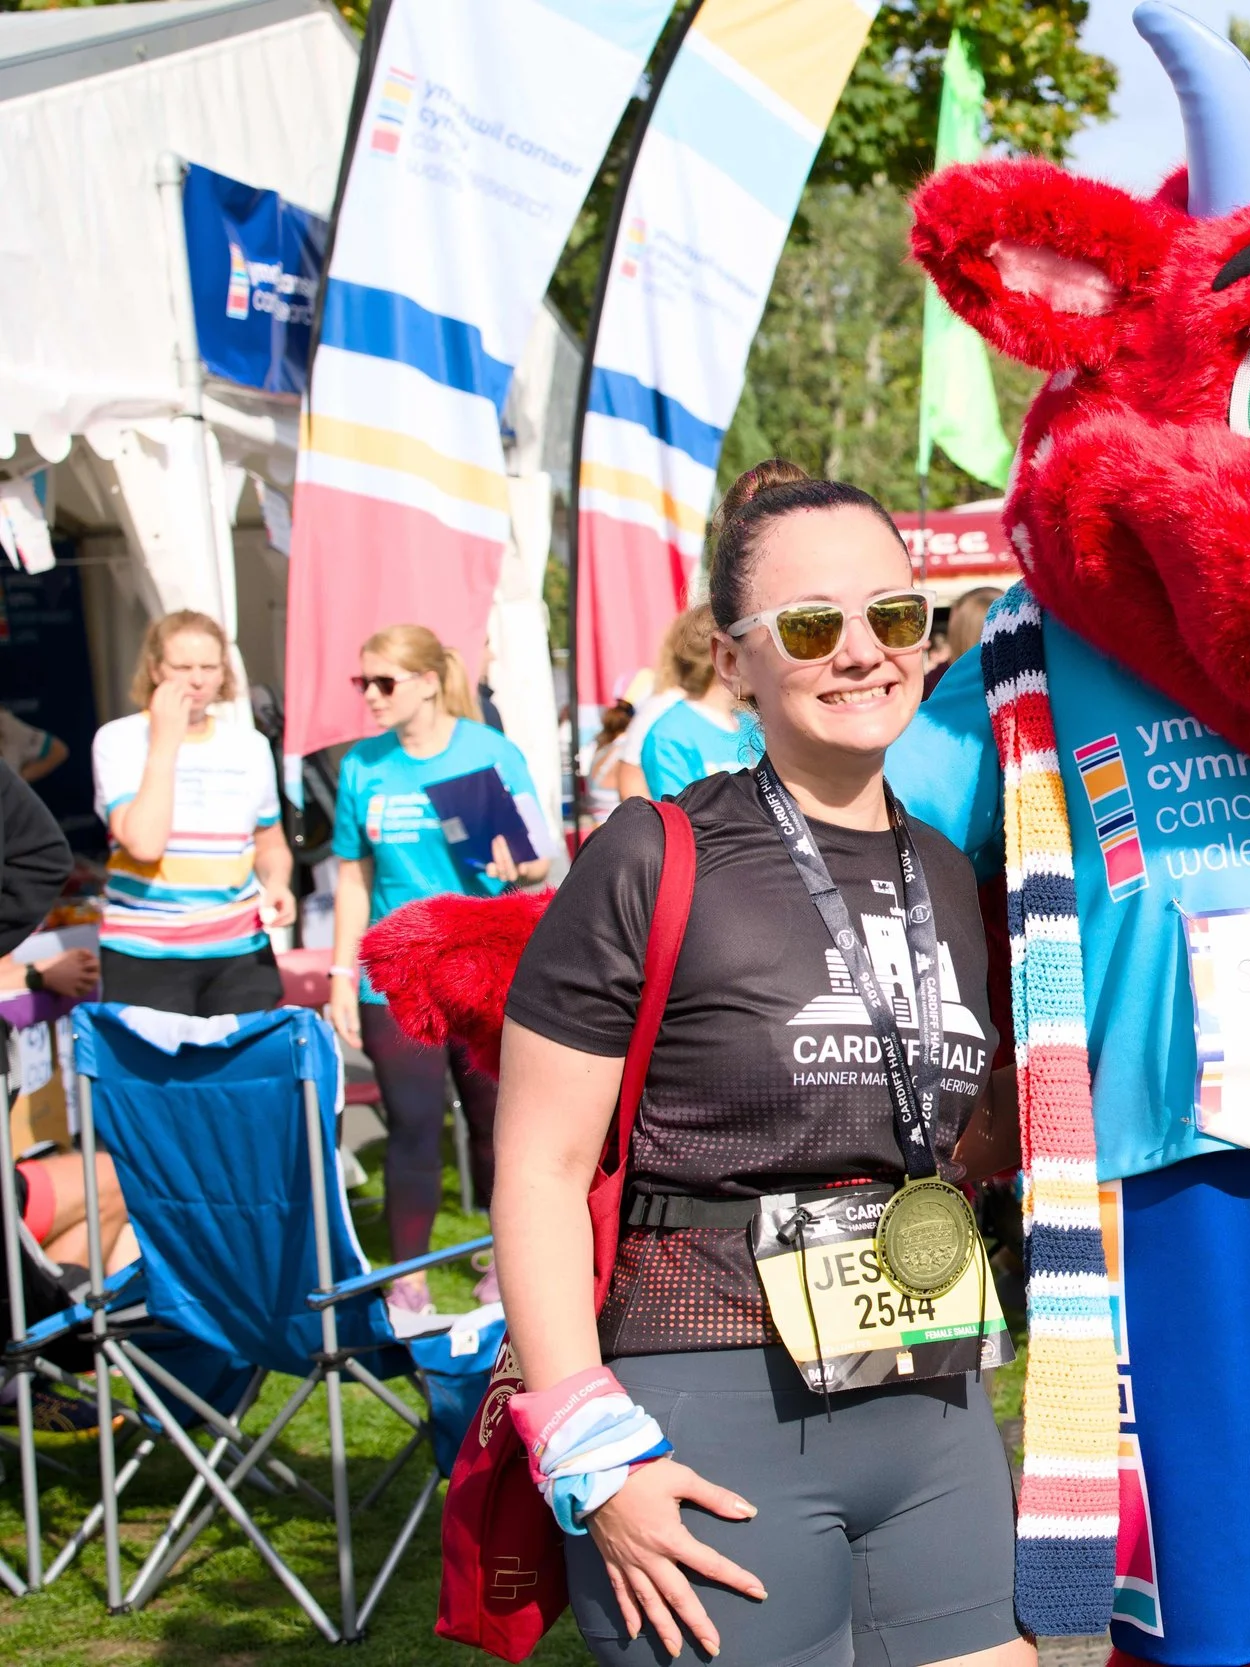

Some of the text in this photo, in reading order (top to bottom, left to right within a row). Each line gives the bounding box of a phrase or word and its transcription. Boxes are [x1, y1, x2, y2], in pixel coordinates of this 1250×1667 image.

[757, 770, 772, 793] HALF
[764, 792, 796, 836] CARDIFF
[900, 849, 916, 883] 2026
[859, 971, 881, 1009] 2026
[926, 976, 940, 1065] CARDIFF HALF
[793, 1071, 857, 1086] HANNER
[940, 1077, 979, 1097] AERDYDD
[882, 1035, 912, 1123] CARDIFF HALF
[846, 1203, 886, 1220] CARD
[854, 1292, 936, 1330] 2544
[925, 1324, 979, 1340] FEMALE SMALL
[539, 1393, 580, 1443] ymchwil
